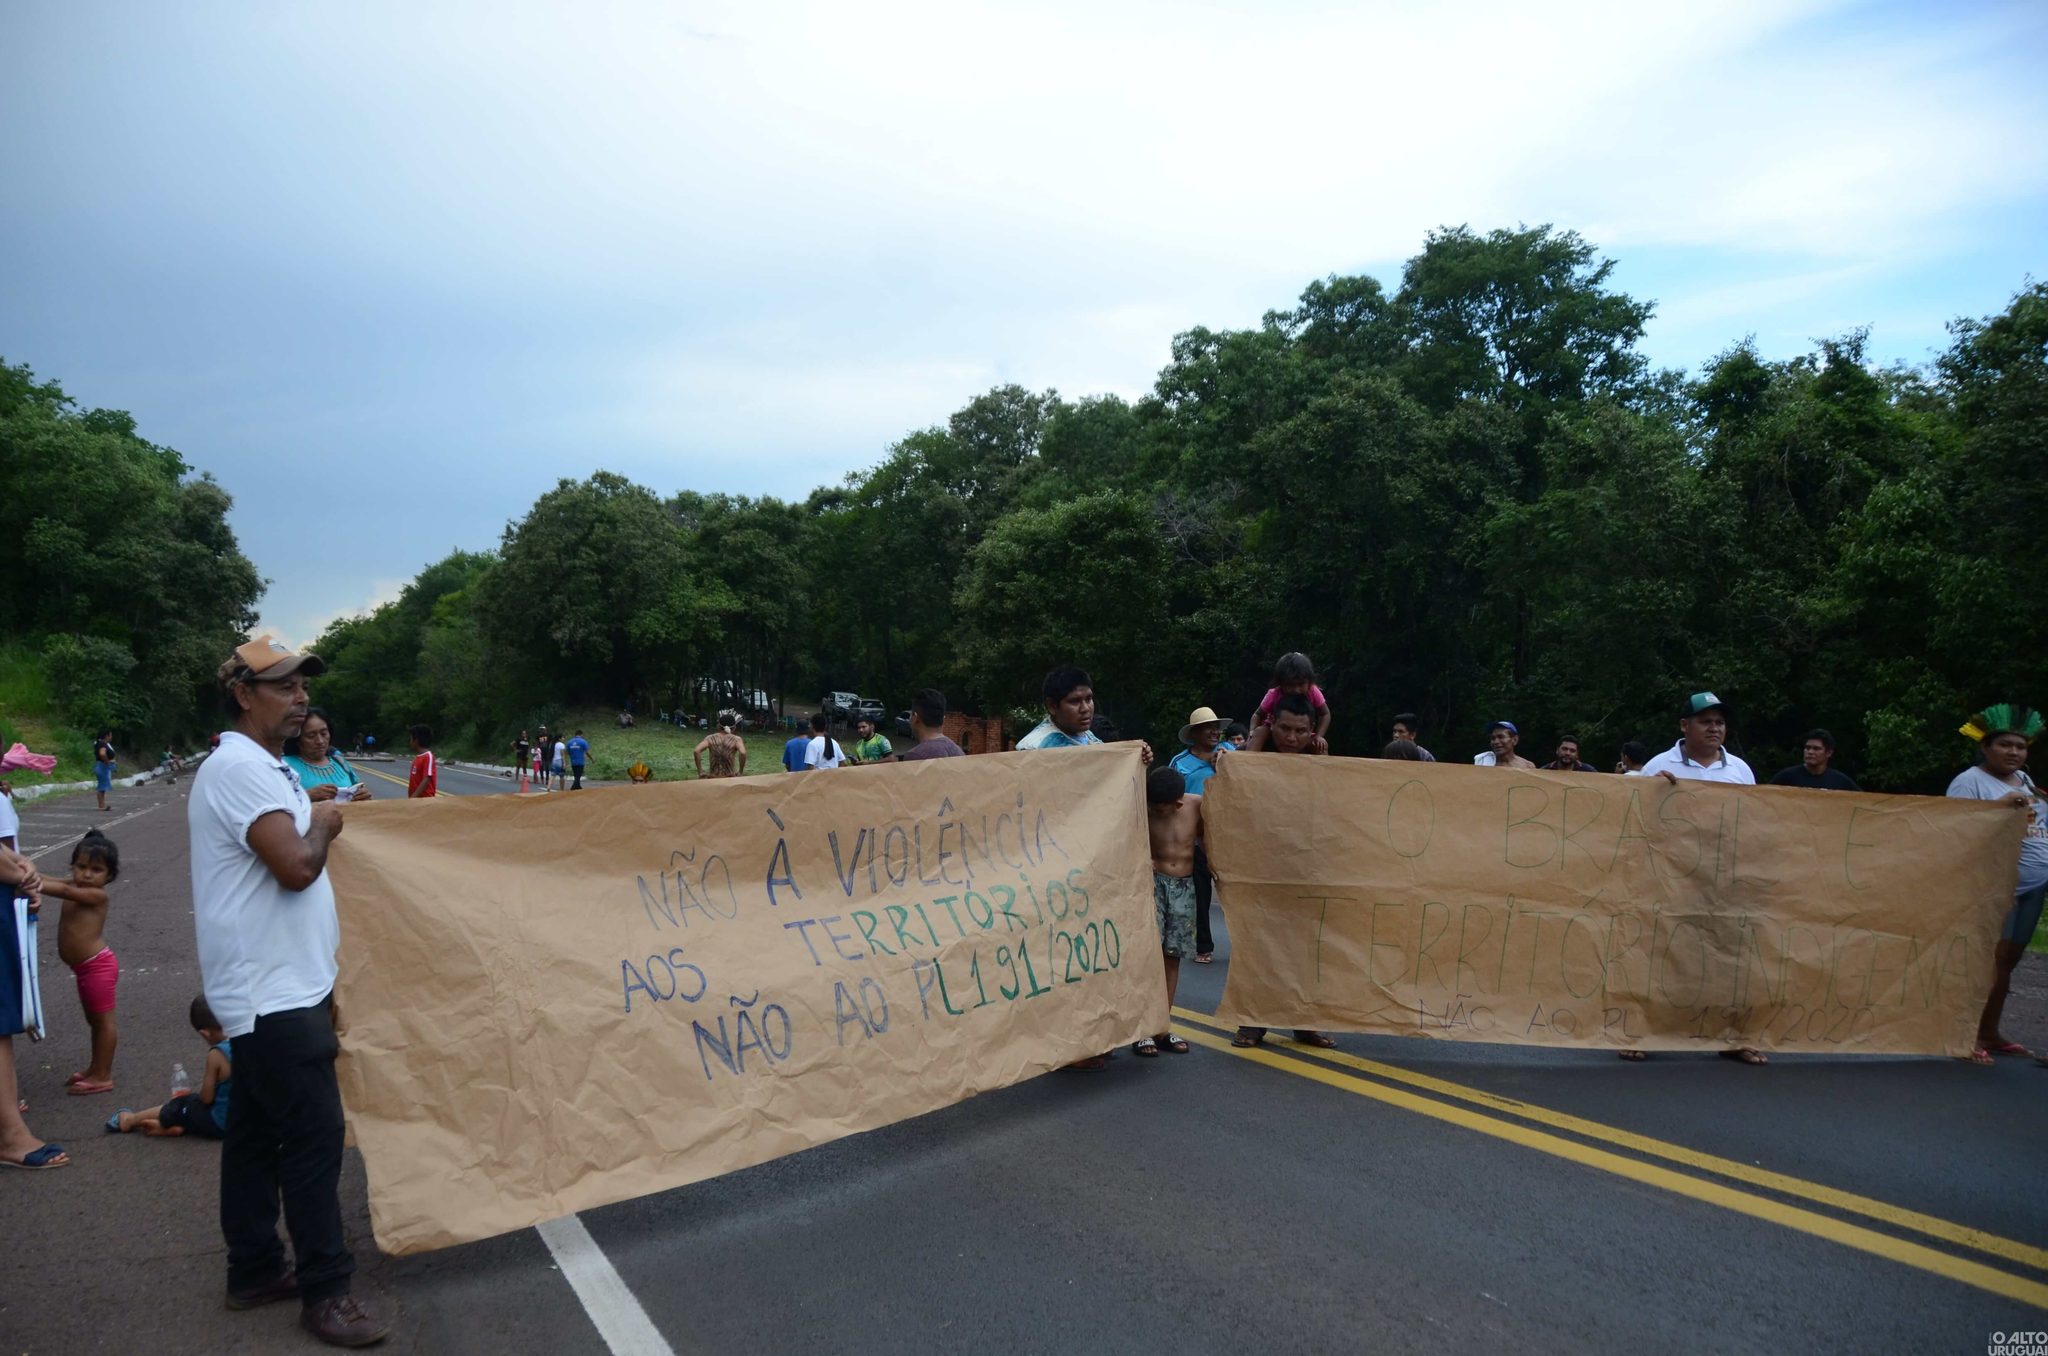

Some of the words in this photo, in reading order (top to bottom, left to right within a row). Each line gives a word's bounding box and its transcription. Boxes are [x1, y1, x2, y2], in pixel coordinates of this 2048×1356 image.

[637, 845, 737, 930] NÃO
[766, 808, 802, 906] À
[828, 791, 1070, 897] VIOLÊNCIA
[1387, 779, 1436, 859] O
[1505, 785, 1781, 890] BRASIL
[621, 947, 707, 1013] AOS
[692, 989, 793, 1081] NÃO
[834, 977, 890, 1047] AO
[1419, 993, 1496, 1034] NÃO
[1527, 1003, 1577, 1035] AO
[1603, 1007, 1642, 1039] PL
